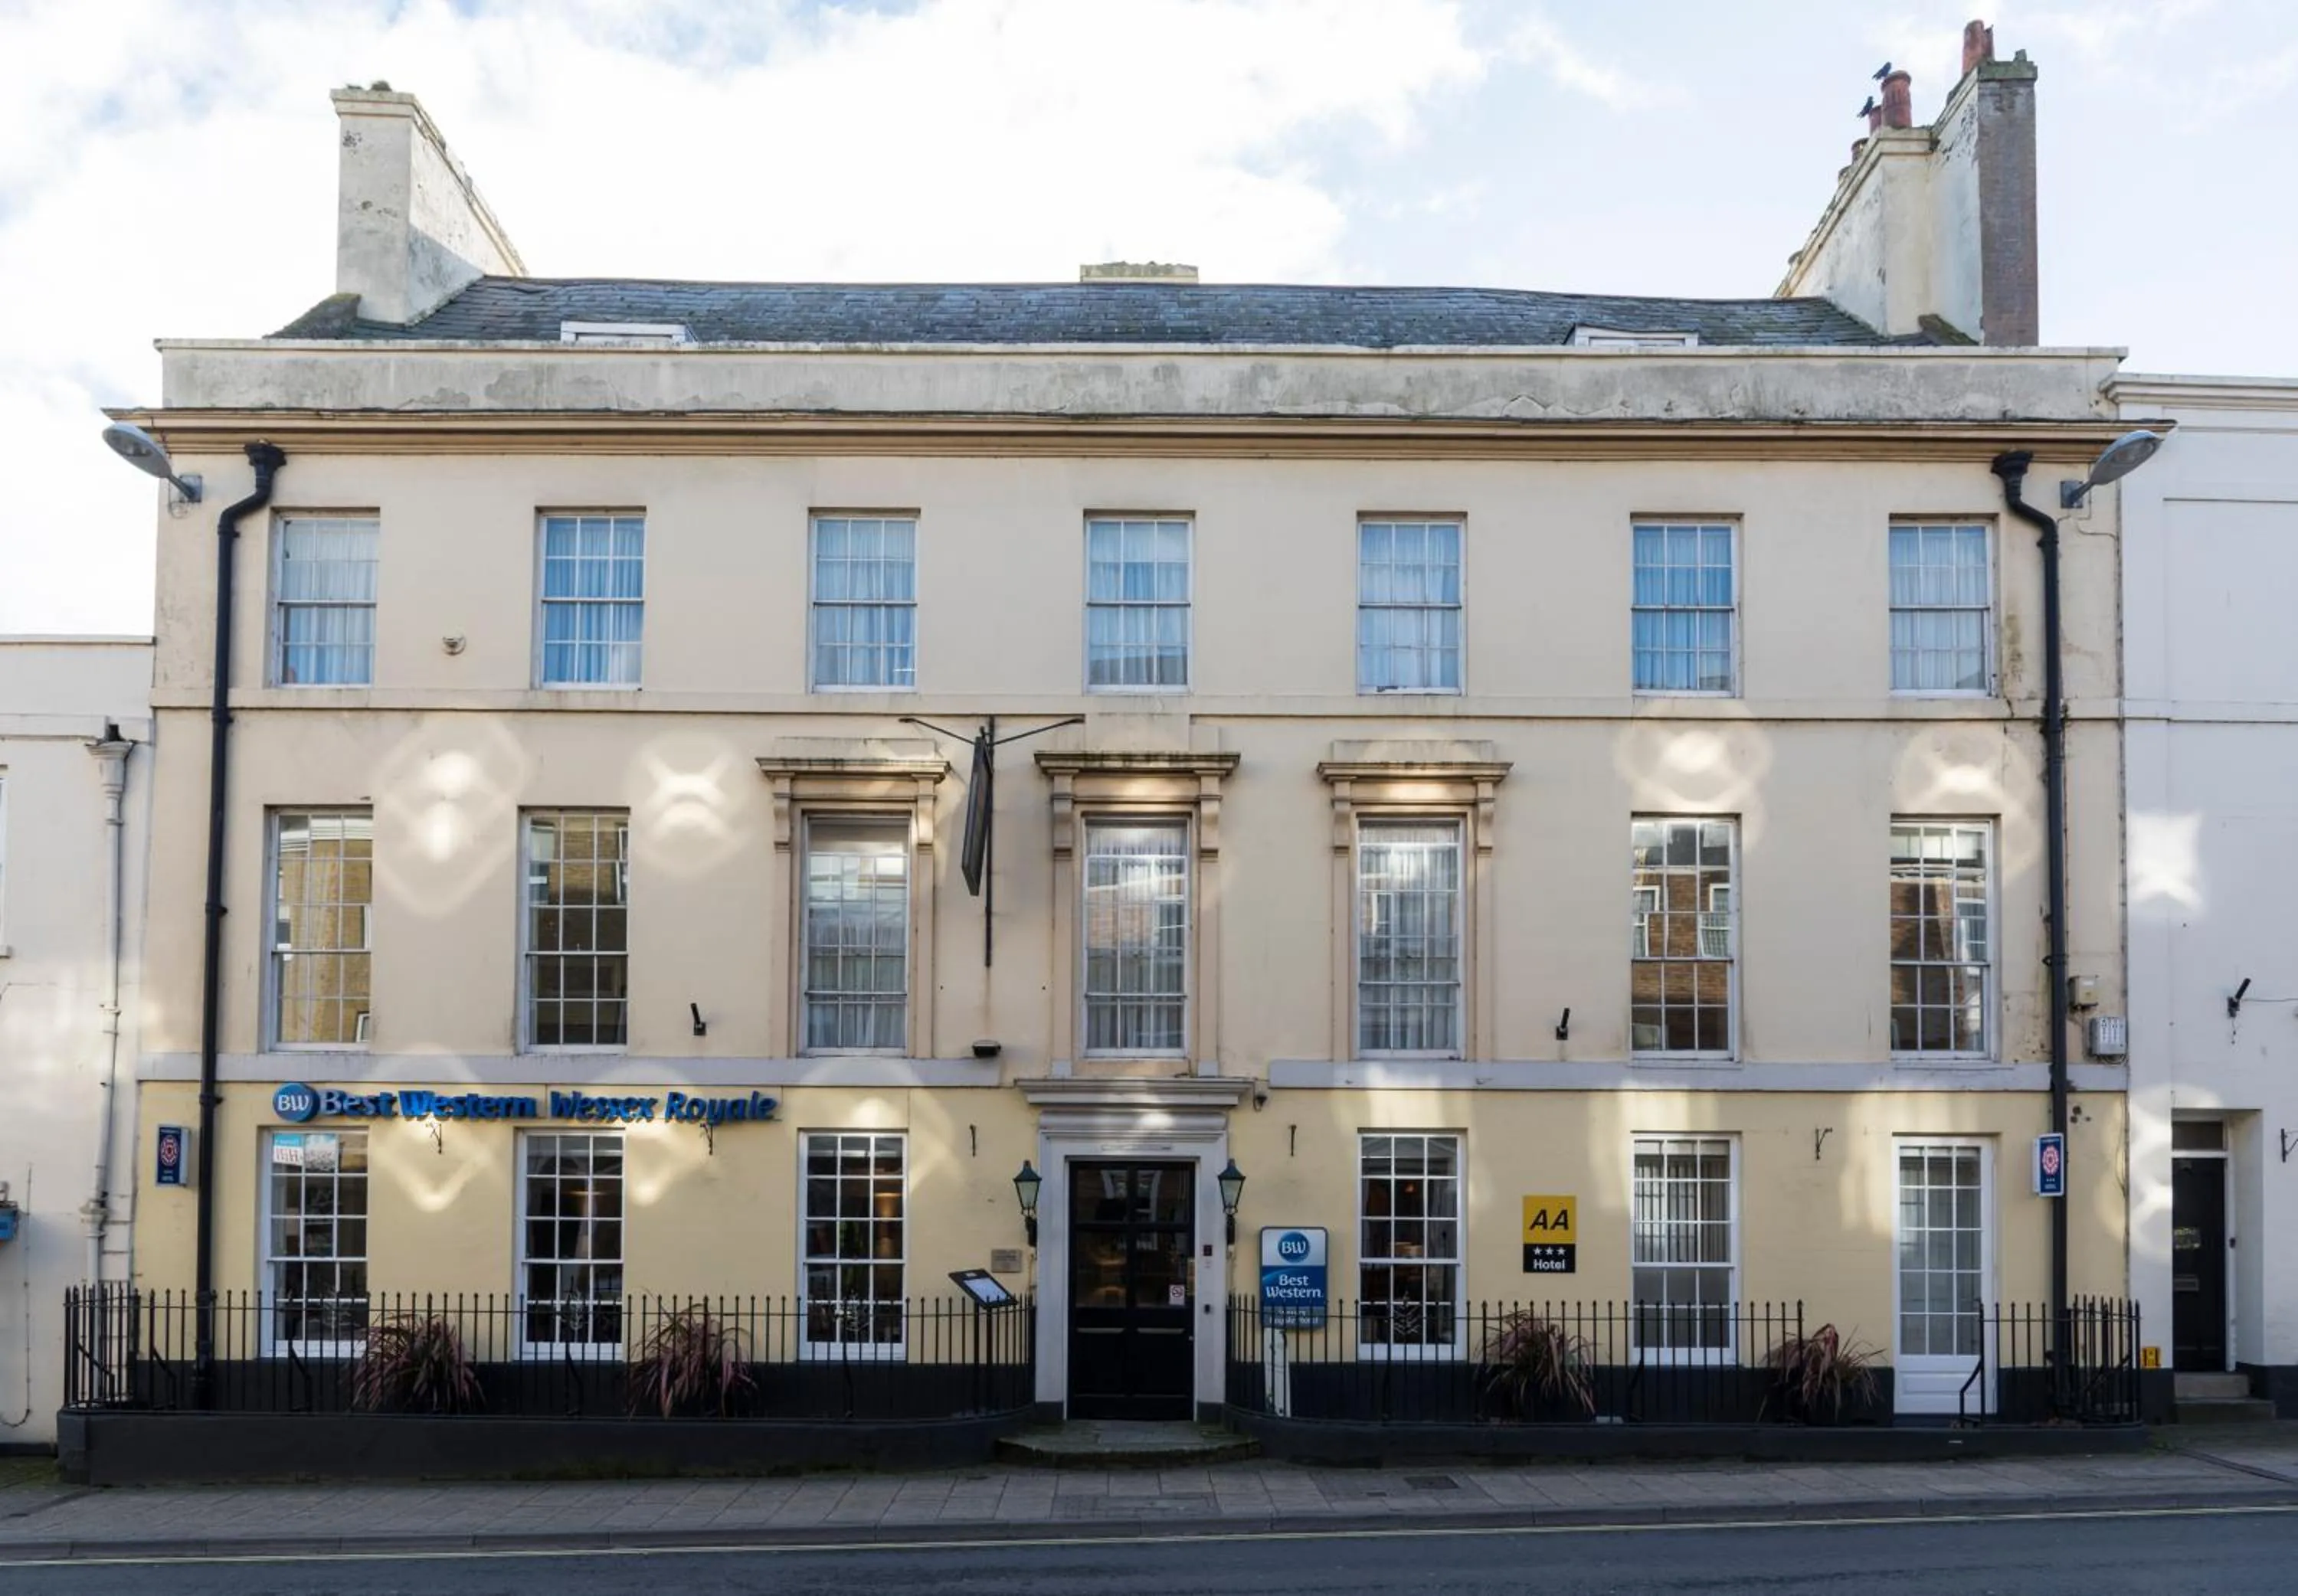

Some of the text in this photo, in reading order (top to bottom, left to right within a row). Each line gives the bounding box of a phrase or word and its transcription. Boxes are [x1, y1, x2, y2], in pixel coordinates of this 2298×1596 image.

[277, 1094, 310, 1112] BW
[318, 1088, 778, 1126] Best Western Wessex Royale
[1529, 1208, 1570, 1231] AA
[1282, 1240, 1307, 1254] BW
[1533, 1258, 1566, 1271] Hotel
[1278, 1274, 1309, 1286] Best
[1265, 1286, 1322, 1299] Western
